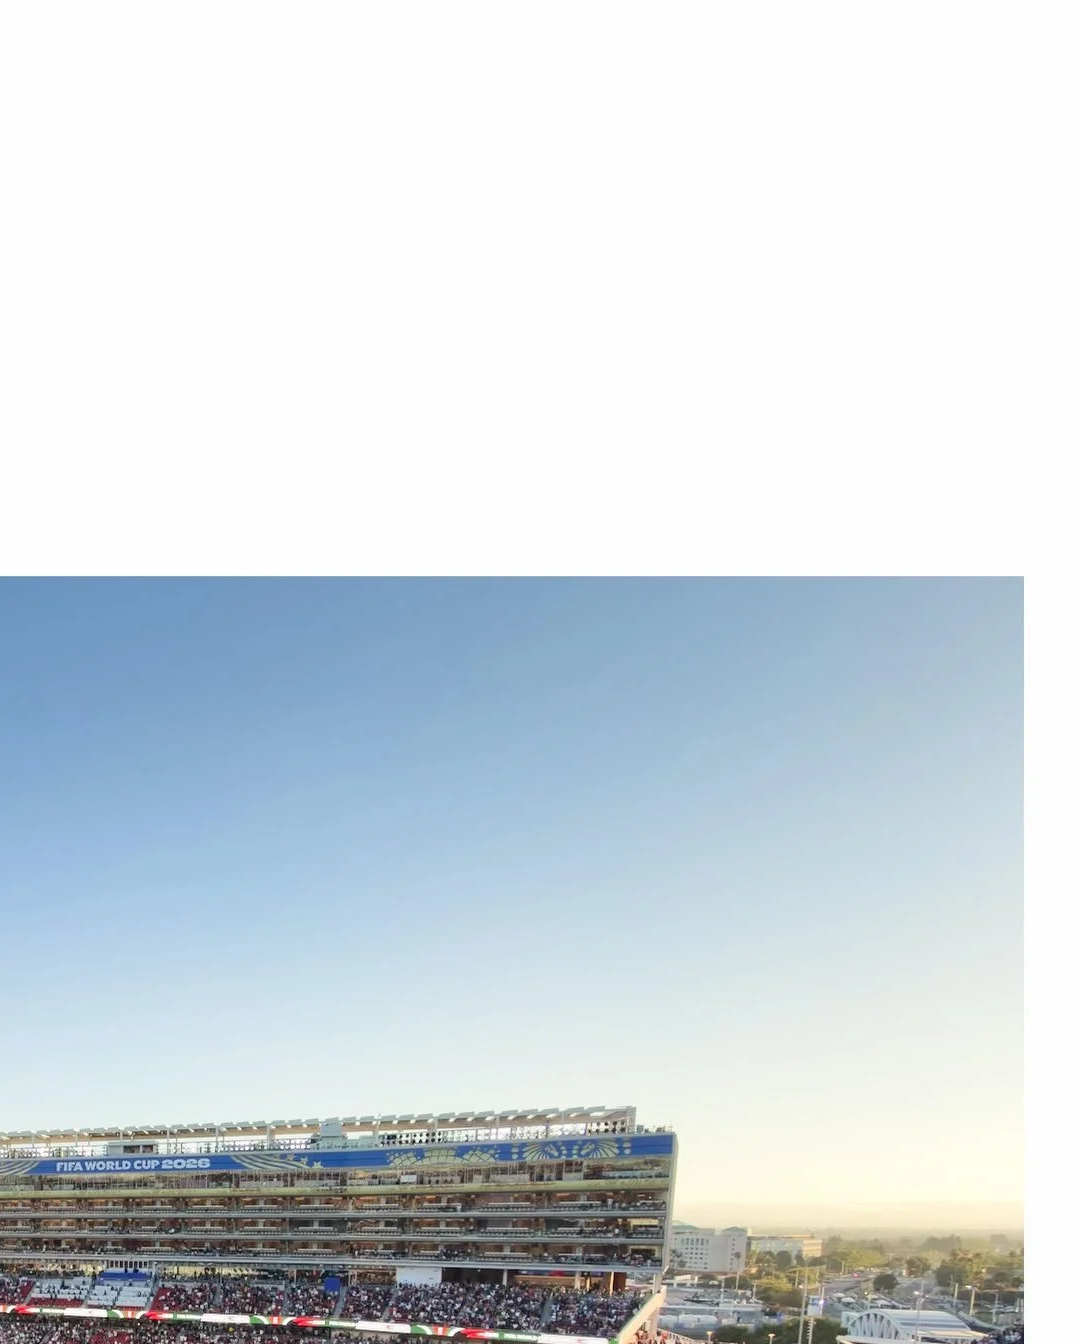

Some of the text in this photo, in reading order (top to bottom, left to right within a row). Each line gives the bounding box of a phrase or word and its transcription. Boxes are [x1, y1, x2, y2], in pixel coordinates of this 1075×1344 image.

[56, 1157, 211, 1171] FIFA WORLD CUP 2026
